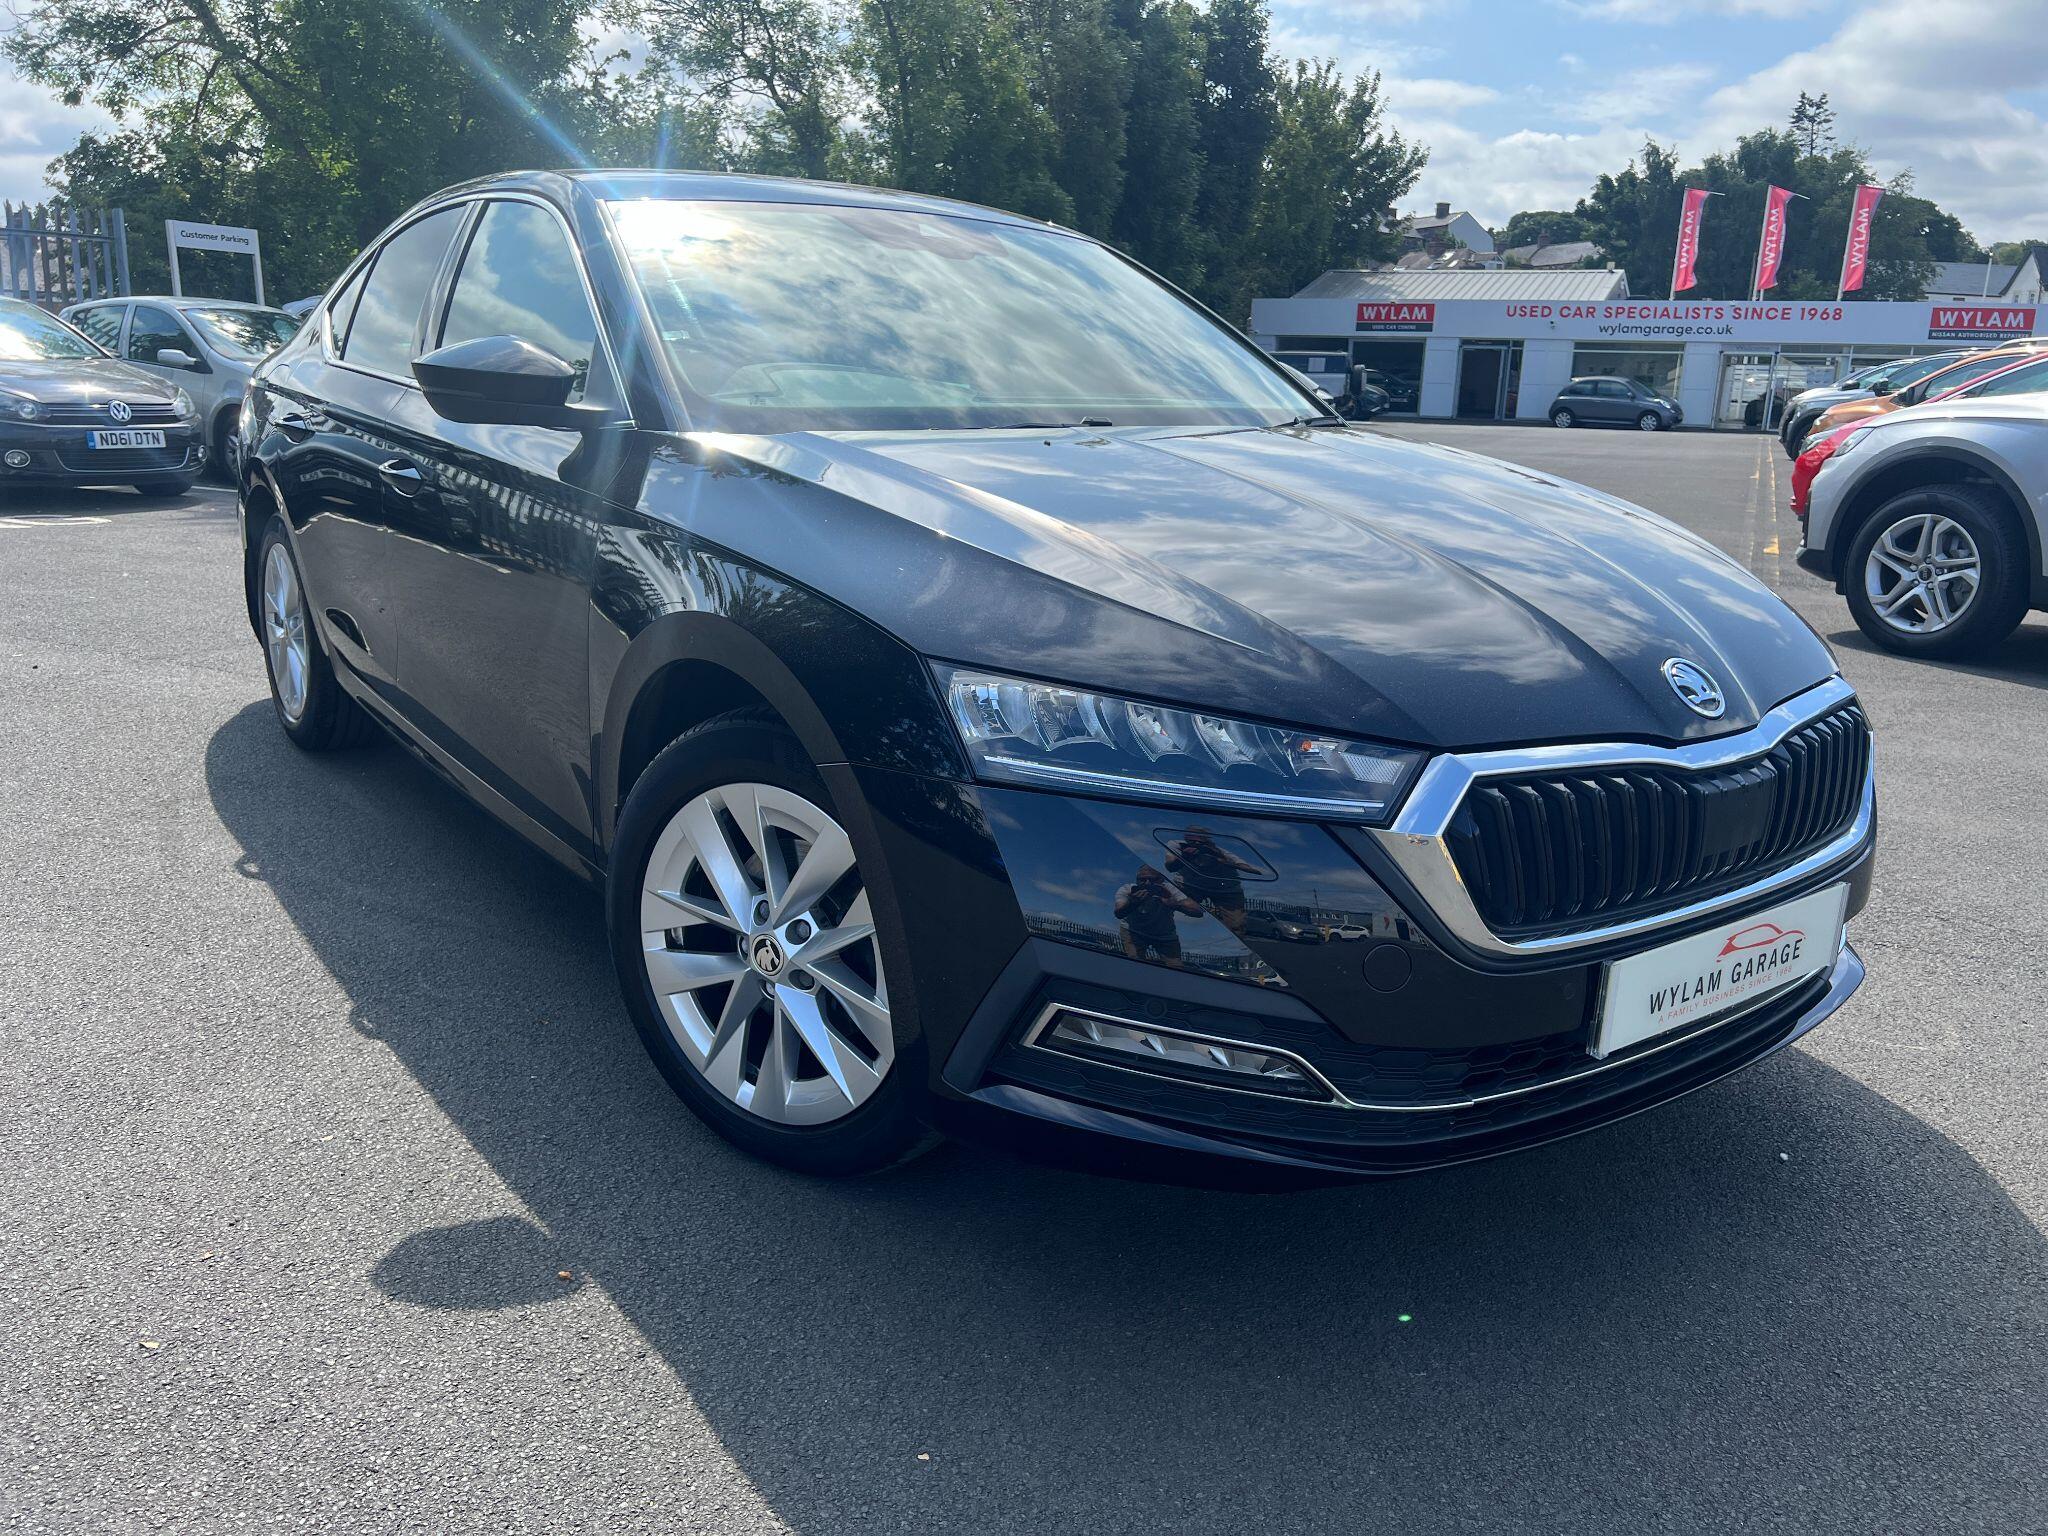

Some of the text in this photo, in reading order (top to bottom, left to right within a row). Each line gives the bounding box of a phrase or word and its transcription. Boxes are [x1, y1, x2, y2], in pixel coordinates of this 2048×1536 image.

[180, 230, 249, 246] Customer Parking
[1679, 210, 1696, 268] WYLAM
[1763, 207, 1780, 268] WYLAM
[1850, 207, 1870, 268] WYLAM
[1362, 306, 1427, 320] WYLAM
[1506, 305, 1843, 321] USED CAR SPECIALISTS SINCE 1968
[1939, 310, 2024, 328] WYLAM
[1599, 323, 1735, 337] wylamgarage.co.uk
[1957, 331, 1998, 339] AUTHORISED
[99, 431, 161, 446] ND61 DTN
[1650, 938, 1803, 1014] WYLAM GARAGE
[1658, 1015, 1664, 1024] A
[1667, 1002, 1699, 1019] FAMILY
[1702, 986, 1745, 1007] BUSINESS
[1748, 976, 1773, 989] SINCE
